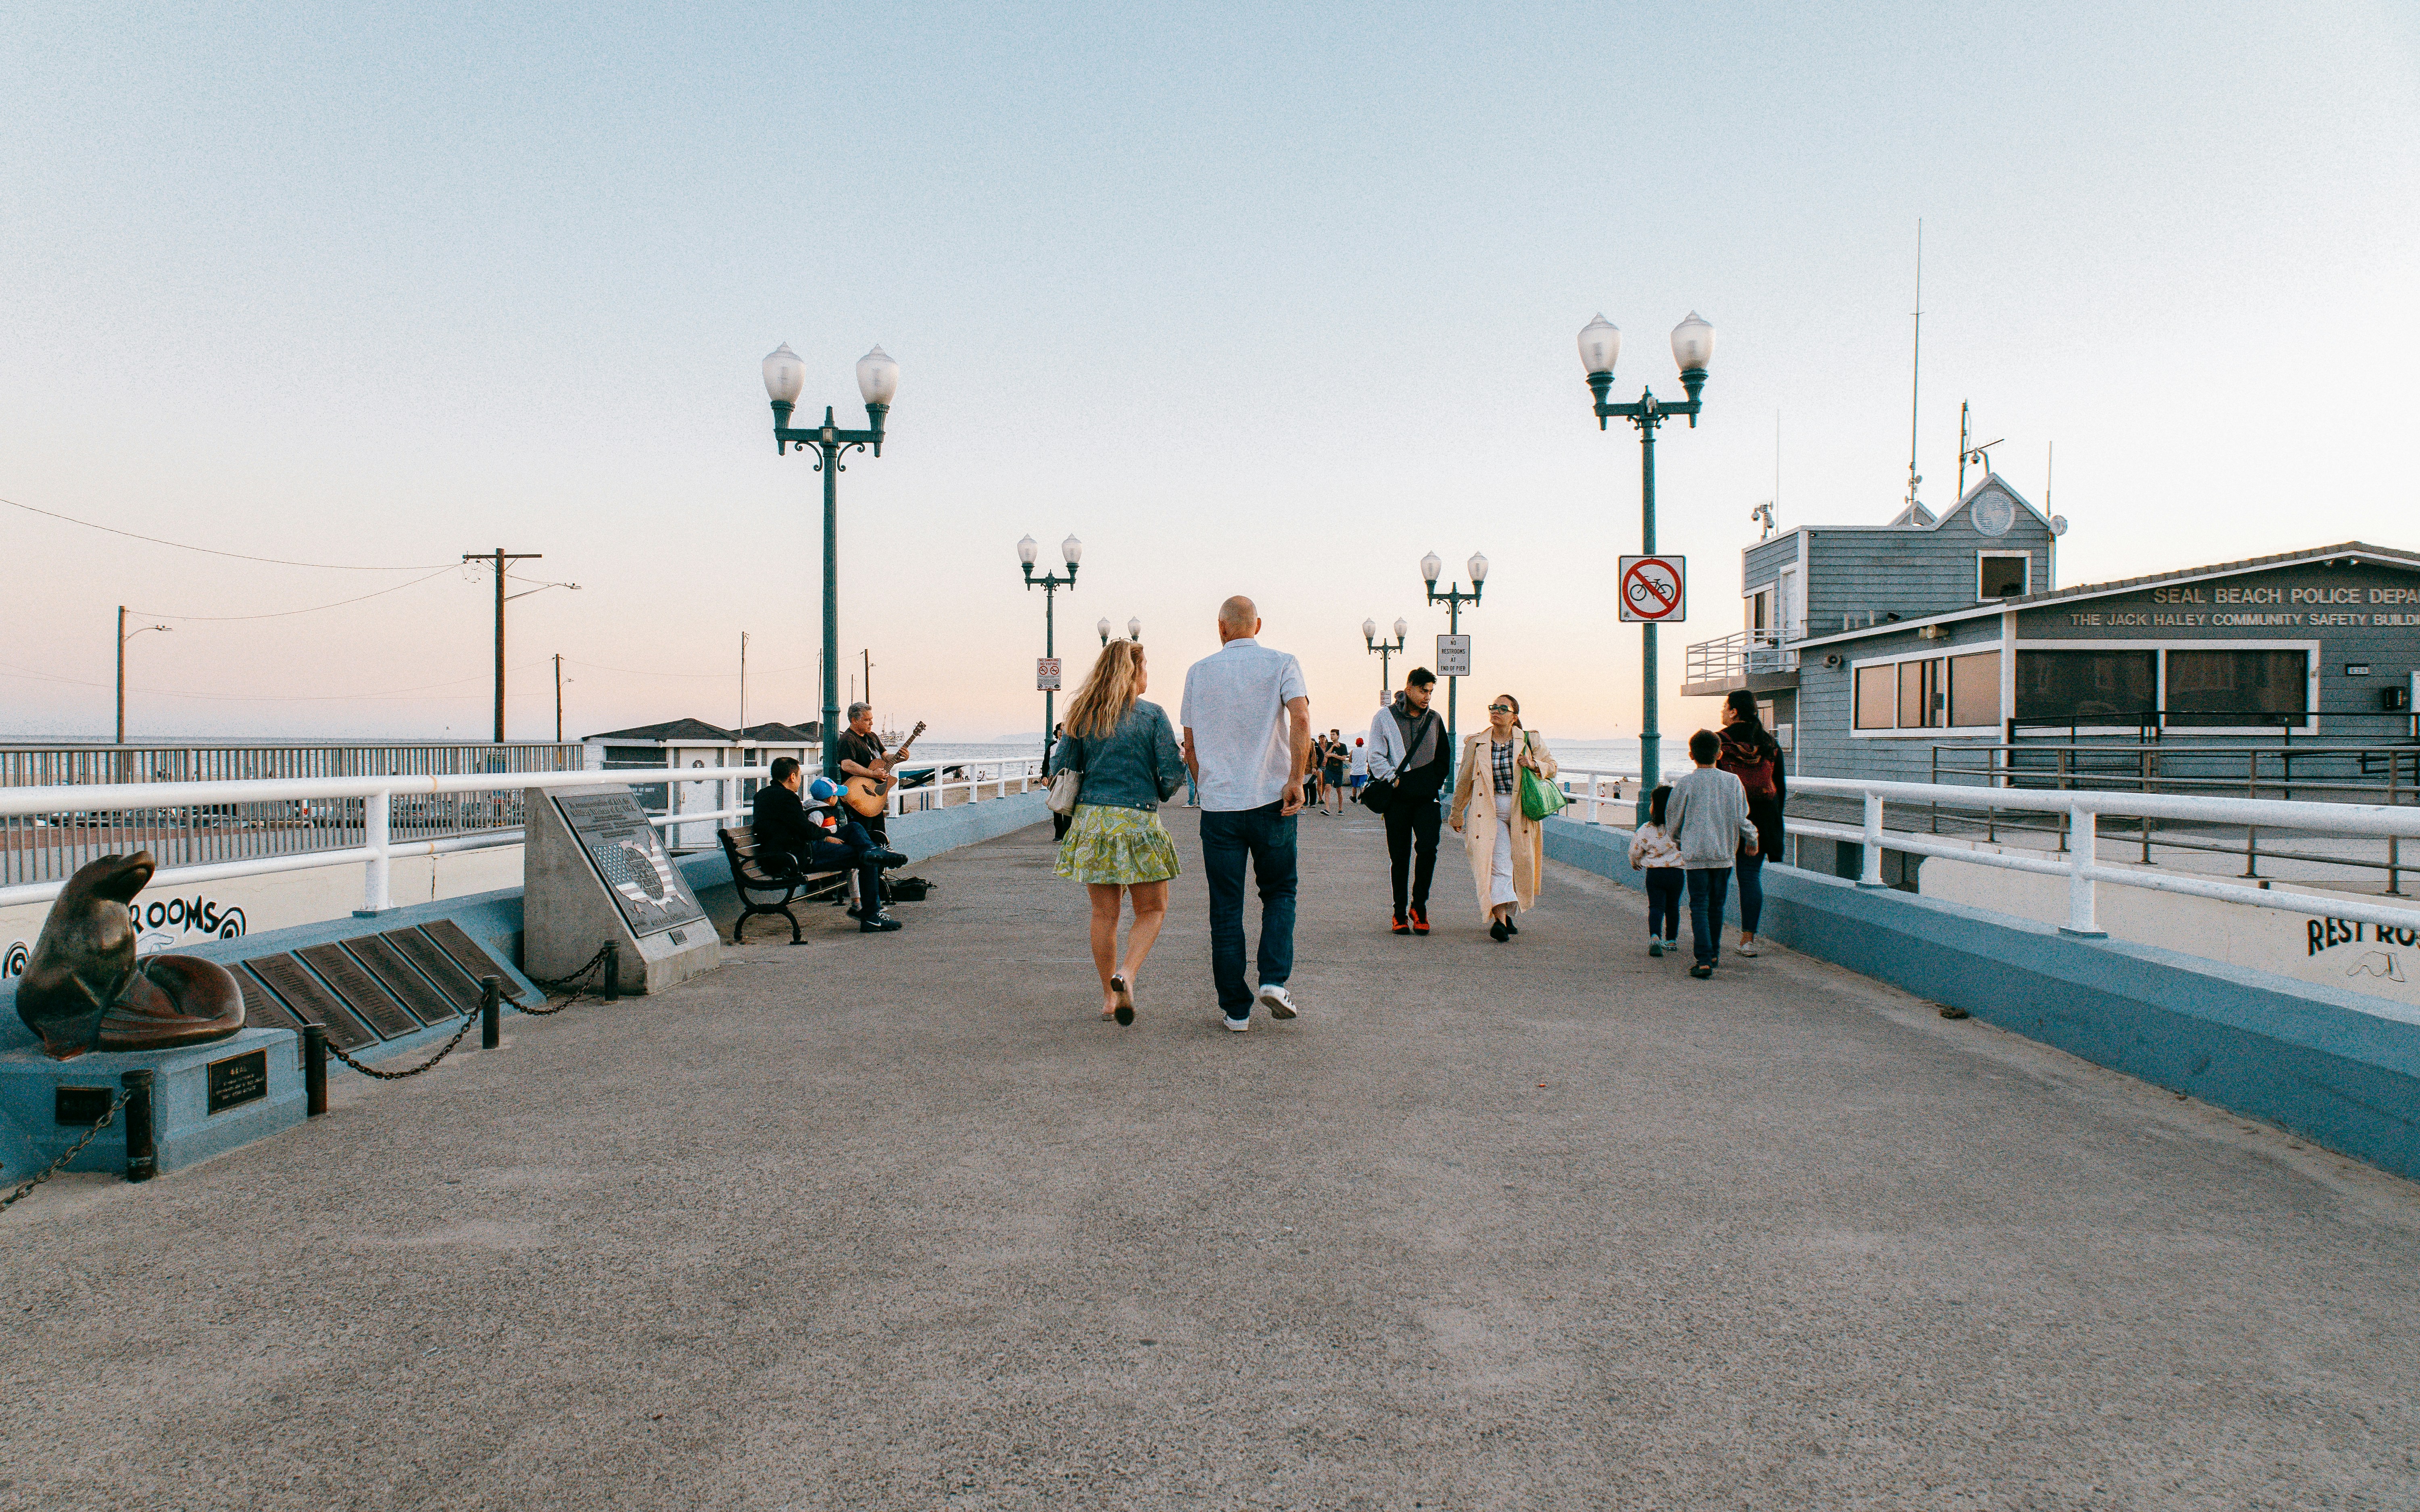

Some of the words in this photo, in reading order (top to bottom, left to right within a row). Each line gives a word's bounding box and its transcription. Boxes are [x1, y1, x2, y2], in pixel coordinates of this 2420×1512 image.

[2154, 588, 2206, 604] SEAL
[2215, 588, 2281, 604] BEACH
[2291, 588, 2361, 604] POLICE
[2071, 614, 2101, 625] THE
[2107, 614, 2147, 625] JACK
[2154, 614, 2205, 625] HALEY
[2213, 614, 2302, 625] COMMUNITY
[2308, 614, 2366, 625] SAFETY
[129, 895, 221, 934] ROOMS
[2307, 916, 2363, 956] REST
[2375, 925, 2420, 950] RO
